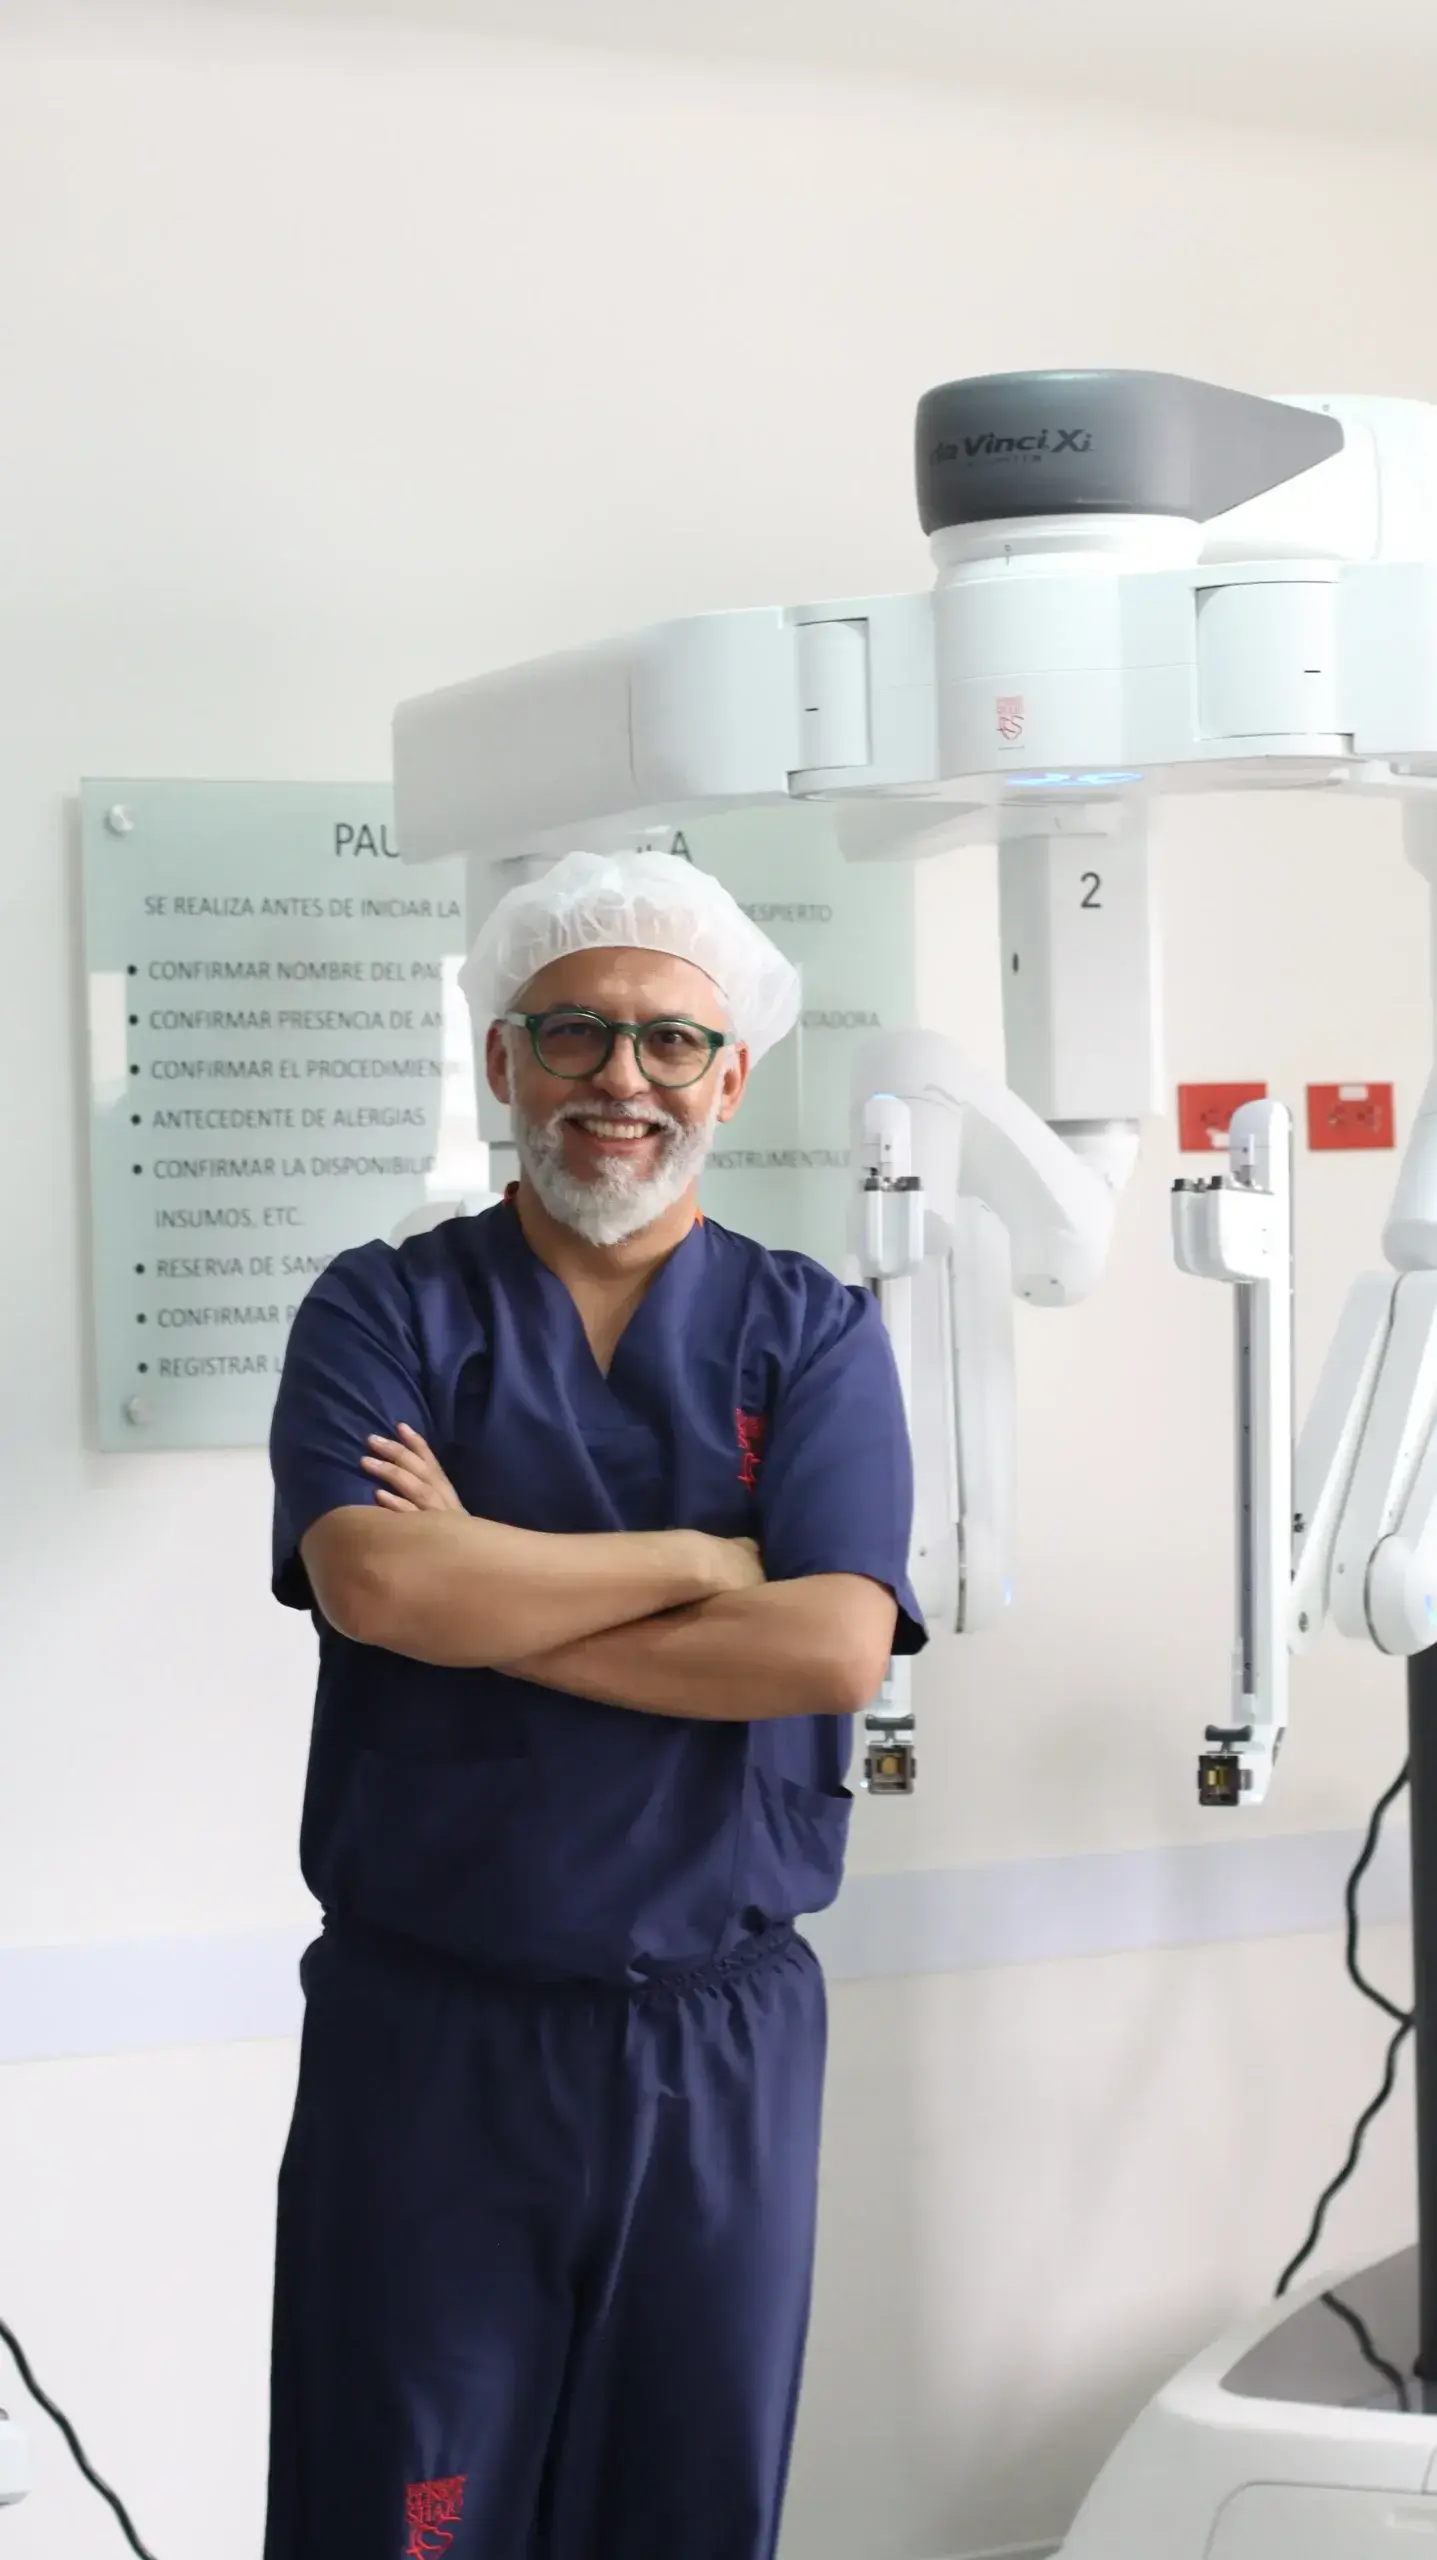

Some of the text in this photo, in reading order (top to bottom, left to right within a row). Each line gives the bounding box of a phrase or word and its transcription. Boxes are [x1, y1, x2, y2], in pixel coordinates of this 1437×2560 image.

[963, 430, 1050, 457] Vinci
[1051, 428, 1098, 453] Xi
[1080, 872, 1102, 909] 2
[145, 896, 461, 918] SE REALIZA ANTES DE INICIAR LA
[149, 961, 271, 981] CONFIRMAR
[277, 961, 366, 981] NOMBRE
[371, 961, 406, 981] DEL
[149, 1010, 272, 1030] CONFIRMAR
[278, 1010, 384, 1030] PRESENCIA
[390, 1010, 414, 1029] DE
[151, 1059, 466, 1080] CONFIRMAR EL PROCEDIMIEN
[153, 1106, 426, 1129] ANTECEDENTE DE ALERGIAS
[154, 1158, 276, 1180] CONFIRMAR
[283, 1157, 306, 1177] LA
[155, 1206, 305, 1230] INSUMOS, ETC.
[157, 1257, 243, 1279] RESERVA
[250, 1256, 275, 1277] DE
[158, 1304, 280, 1327] CONFIRMAR
[159, 1355, 268, 1377] REGISTRAR
